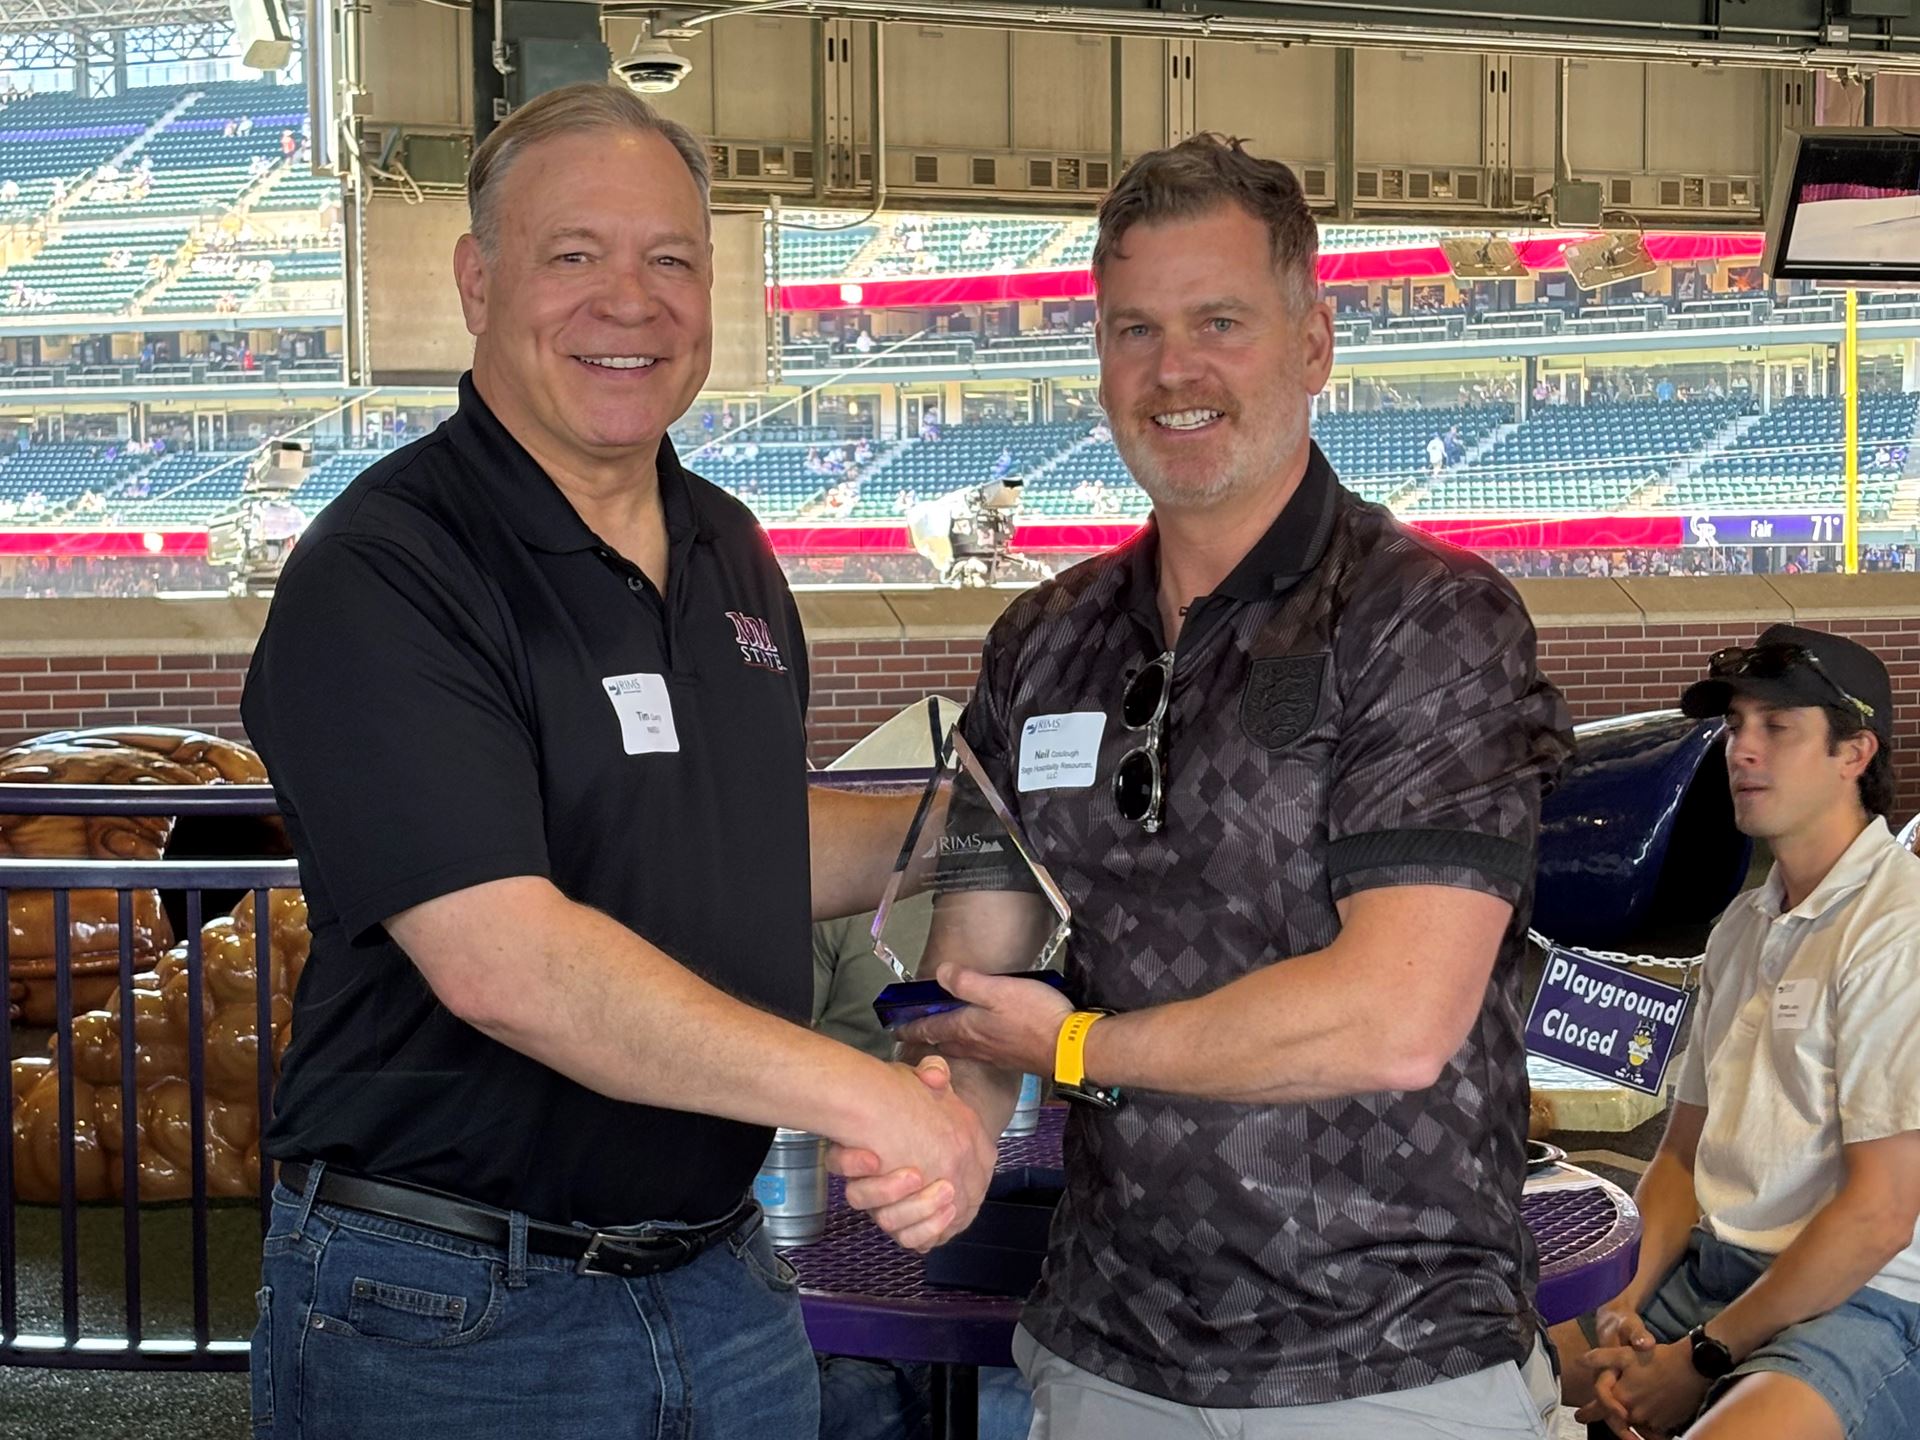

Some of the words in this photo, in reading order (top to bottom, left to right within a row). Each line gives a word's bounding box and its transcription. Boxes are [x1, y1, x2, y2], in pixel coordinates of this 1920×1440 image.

[1750, 519, 1774, 538] Fair
[1810, 515, 1840, 542] 71°
[740, 645, 788, 671] STATE
[619, 679, 641, 690] RIMS
[636, 711, 650, 721] Tim
[1038, 719, 1061, 729] RIMS
[1034, 749, 1050, 760] Neil
[939, 833, 982, 850] RIMS
[1547, 957, 1683, 1027] Playground
[1542, 1008, 1618, 1057] Closed
